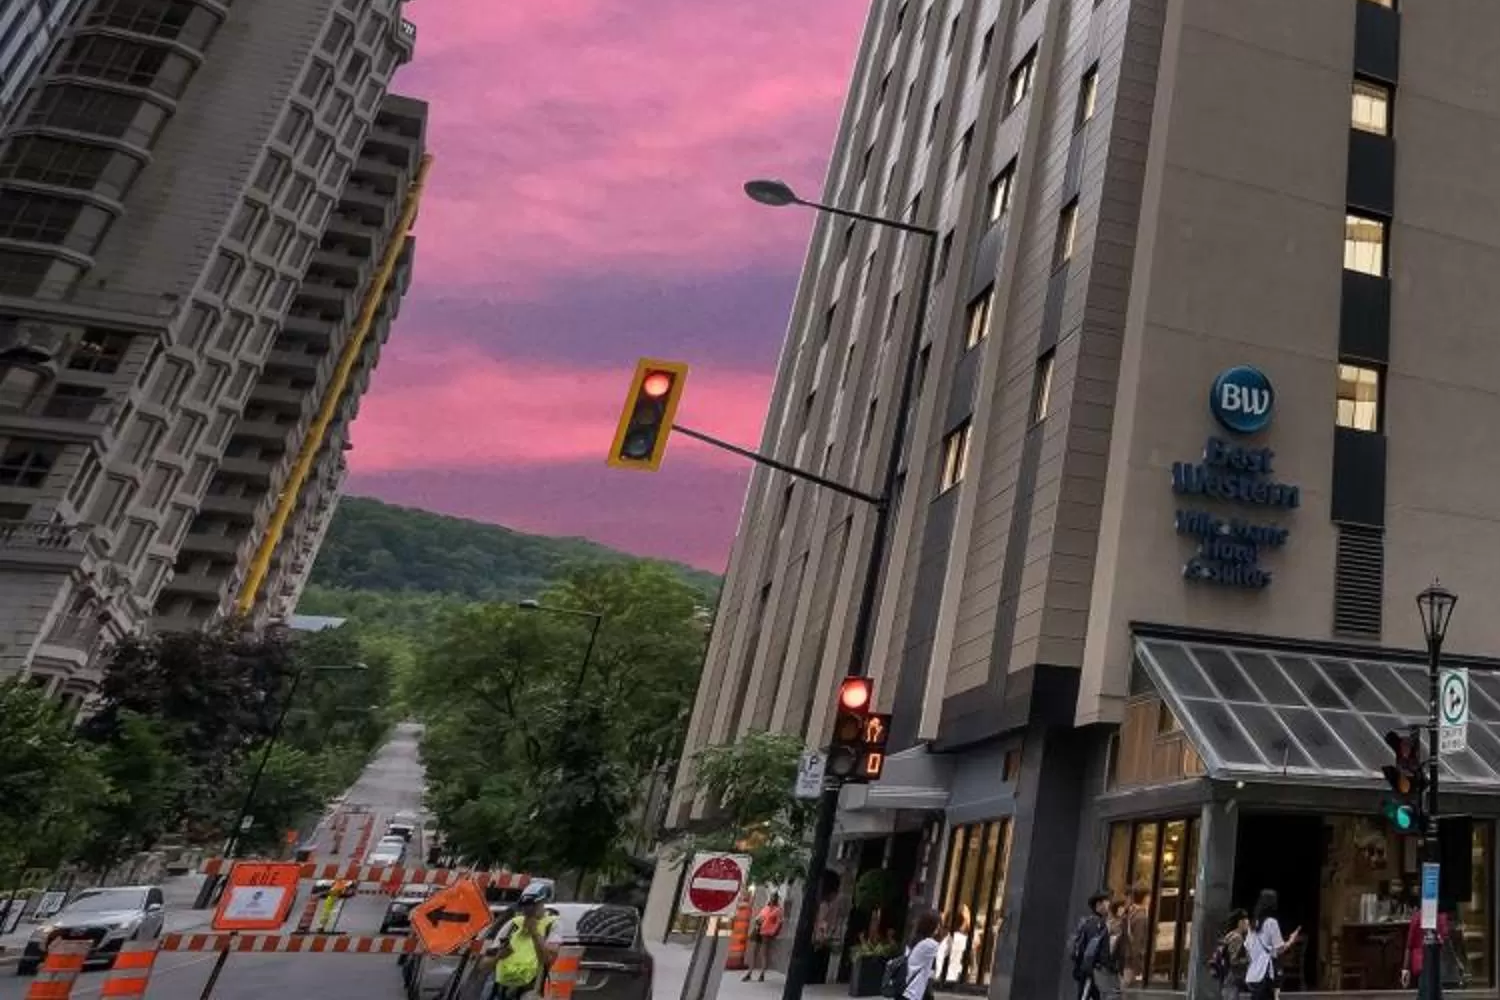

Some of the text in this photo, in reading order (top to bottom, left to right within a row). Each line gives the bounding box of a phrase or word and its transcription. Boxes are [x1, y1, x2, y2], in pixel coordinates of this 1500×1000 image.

[1221, 383, 1269, 415] BW
[1202, 436, 1275, 473] Best
[1171, 461, 1300, 509] Western
